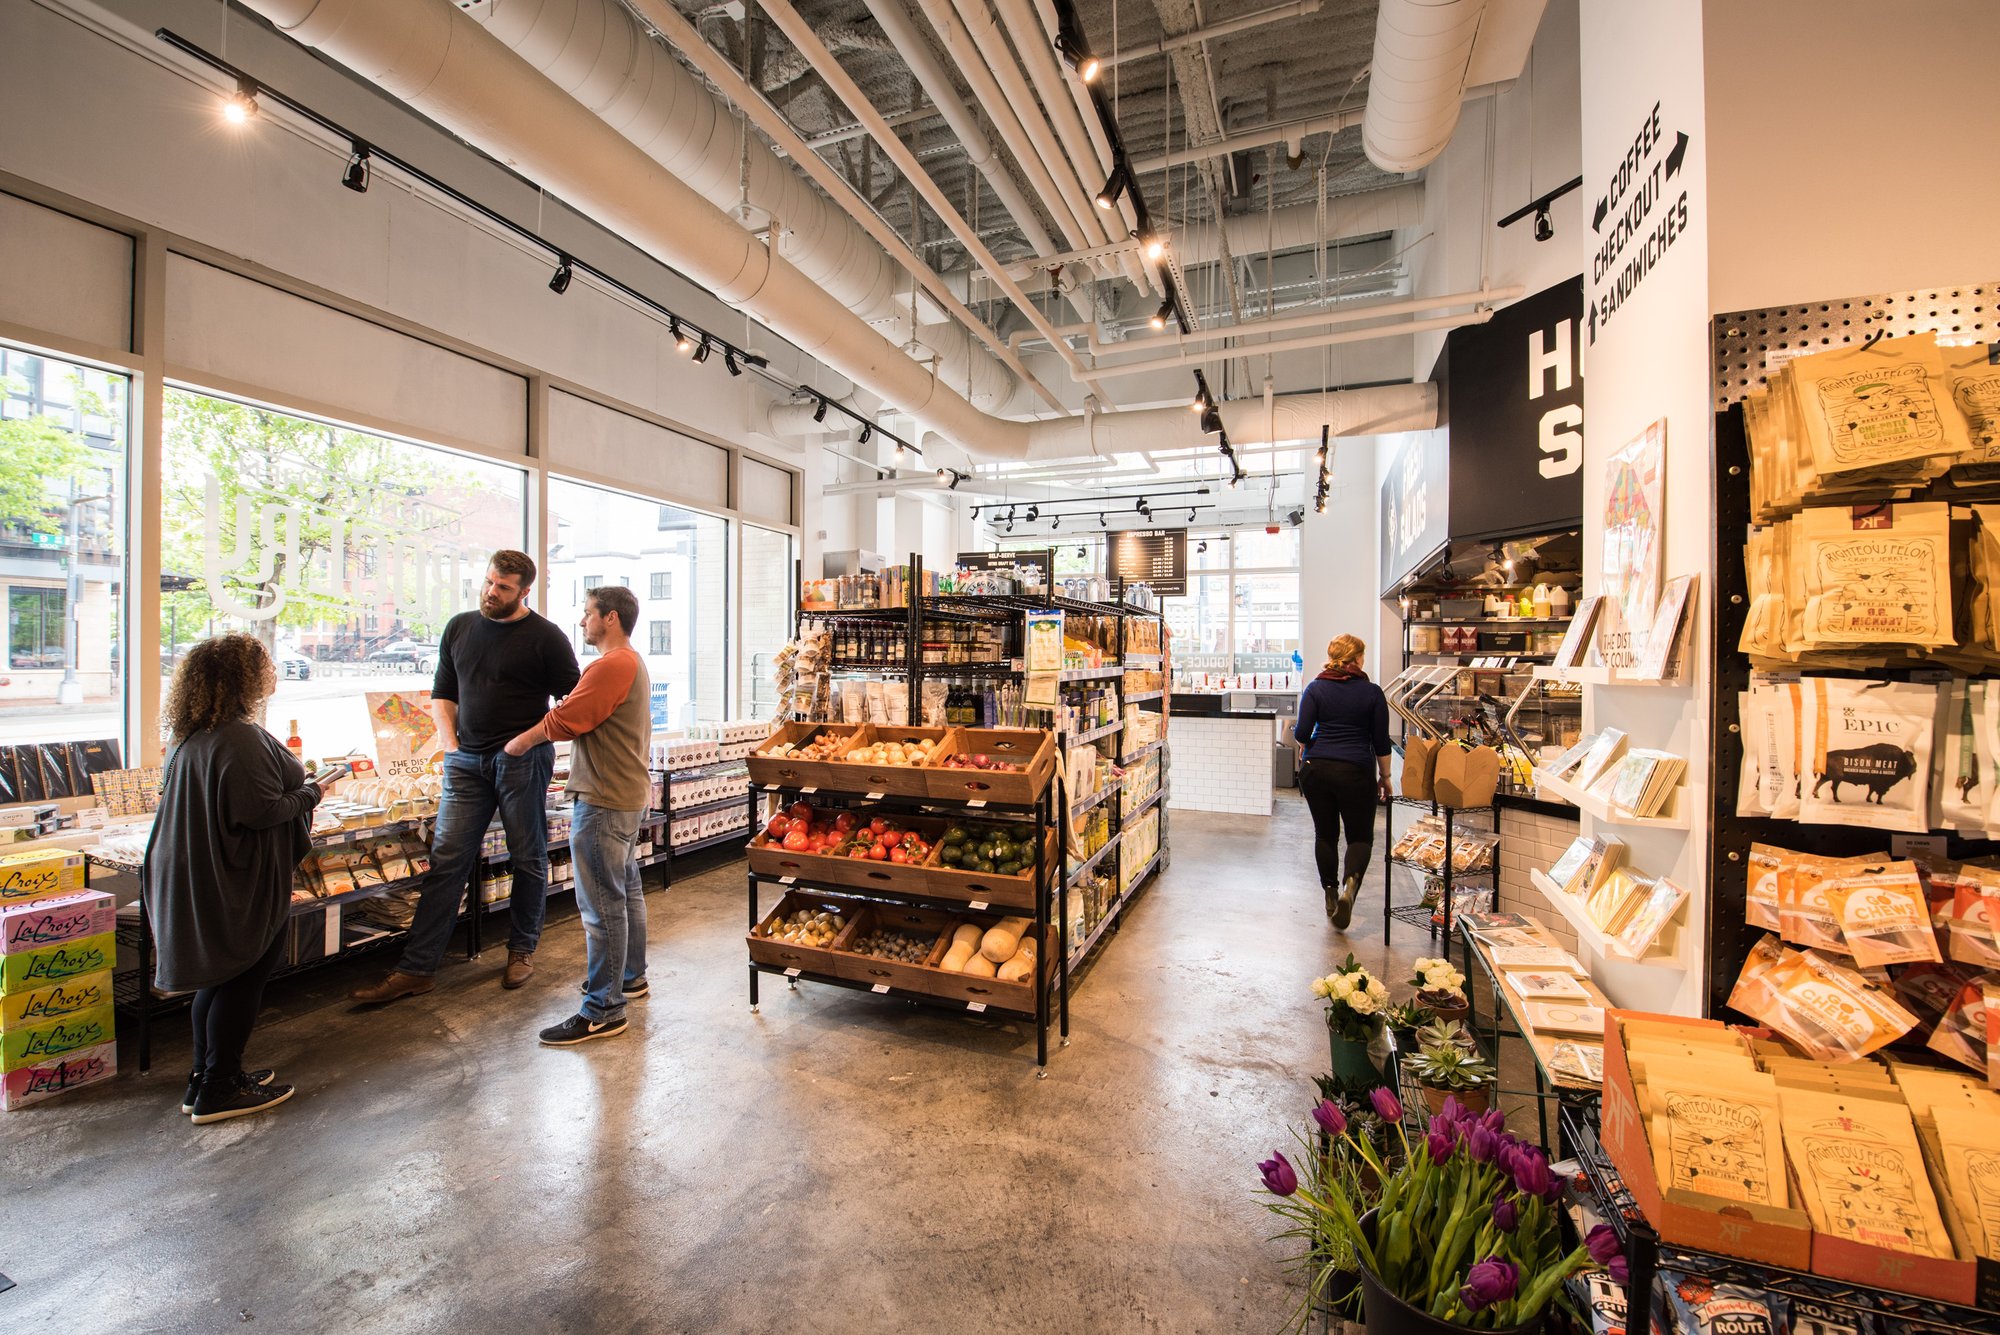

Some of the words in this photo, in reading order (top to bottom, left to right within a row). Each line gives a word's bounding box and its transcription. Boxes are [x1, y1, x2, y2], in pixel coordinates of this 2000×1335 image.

[1609, 100, 1661, 211] COFFEE
[1593, 160, 1662, 286] CHECKOUT
[1600, 191, 1689, 327] SANDWICHES
[1529, 317, 1584, 401] H
[1821, 370, 1880, 392] RIGHTEOUS
[1883, 366, 1922, 382] FELON
[1877, 434, 1913, 443] NATURAL
[1400, 480, 1427, 557] SALADS
[1825, 544, 1889, 563] RIGHTEOUS
[1889, 545, 1930, 561] FELON
[1851, 617, 1904, 626] HICKORY
[1603, 633, 1615, 650] THE
[1844, 718, 1901, 734] EPIC
[388, 768, 402, 776] OF
[391, 760, 408, 768] THE
[1843, 757, 1872, 768] BISON
[1875, 759, 1899, 769] MEAT
[1865, 895, 1892, 905] GO
[1854, 903, 1914, 919] CHEWS
[1801, 987, 1865, 1038] CHEWS
[1826, 991, 1855, 1017] GO
[1669, 1101, 1723, 1117] RIGHTEOUS
[1724, 1107, 1761, 1130] FELON
[1809, 1145, 1864, 1161] RIGHTEOUS
[1866, 1151, 1904, 1175] FELON
[1720, 1172, 1740, 1180] JERKY
[1714, 1321, 1766, 1334] ROUTE
